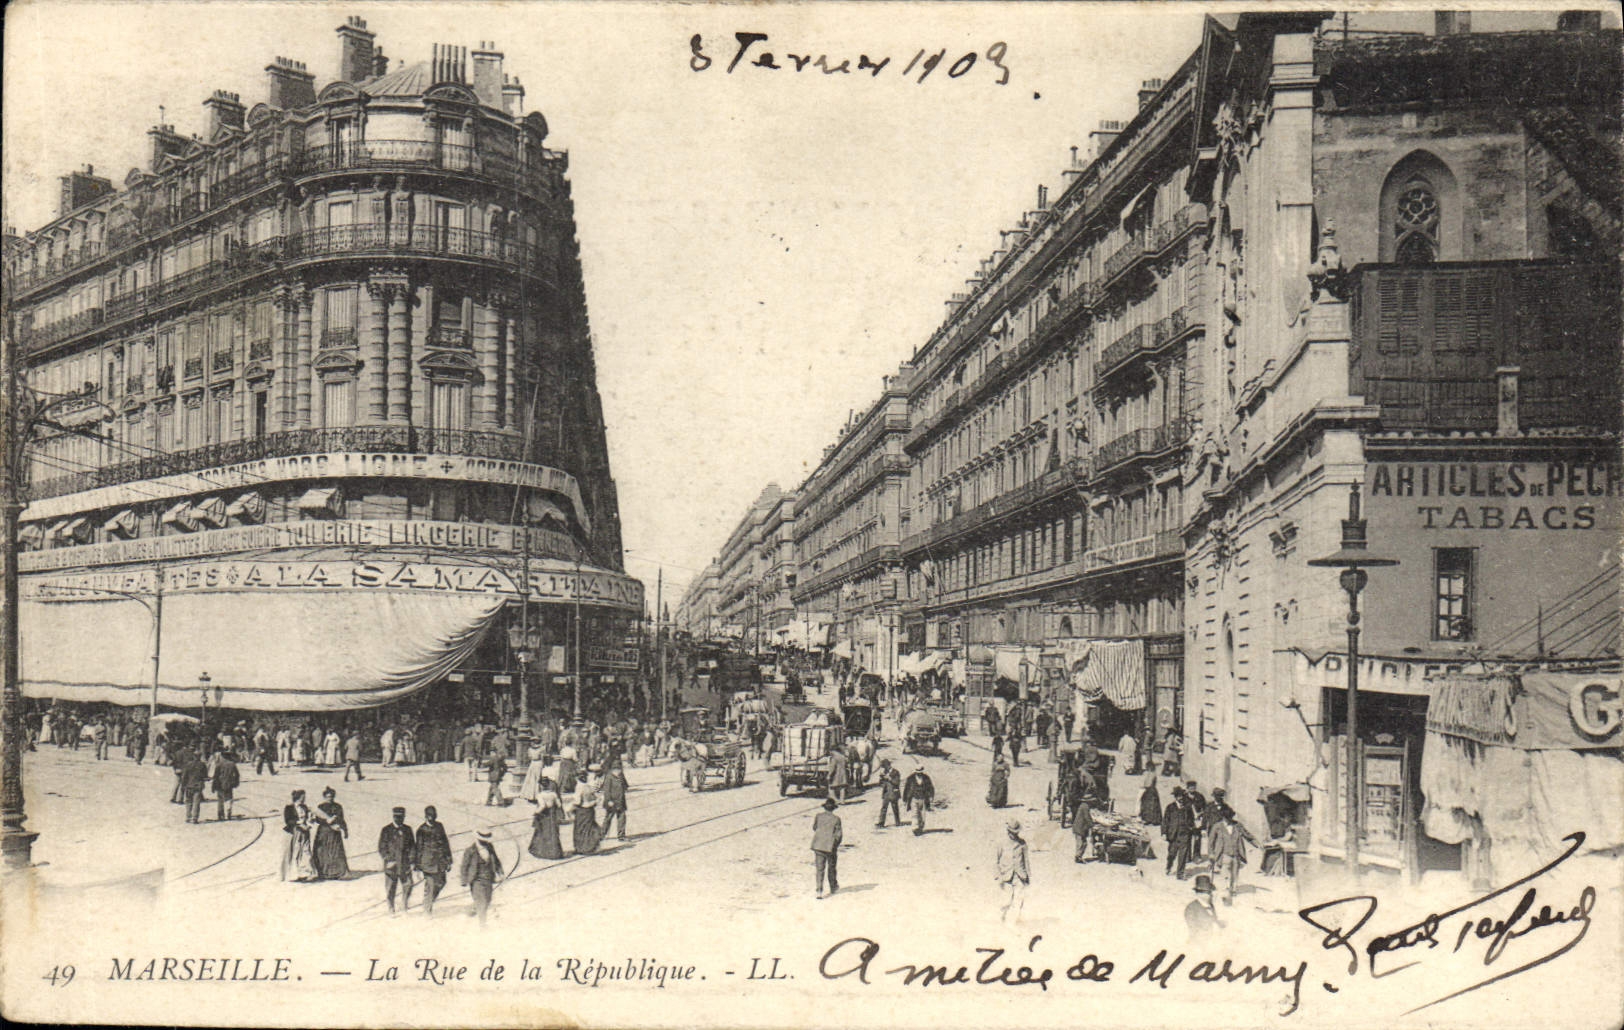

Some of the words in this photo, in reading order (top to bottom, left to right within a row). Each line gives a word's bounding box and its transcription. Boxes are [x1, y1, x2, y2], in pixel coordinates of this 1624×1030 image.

[1371, 462, 1526, 498] ARTICLES
[1529, 483, 1545, 497] DE
[1417, 505, 1596, 531] TABACS
[388, 521, 501, 549] LINGERIE
[1066, 954, 1115, 982] de
